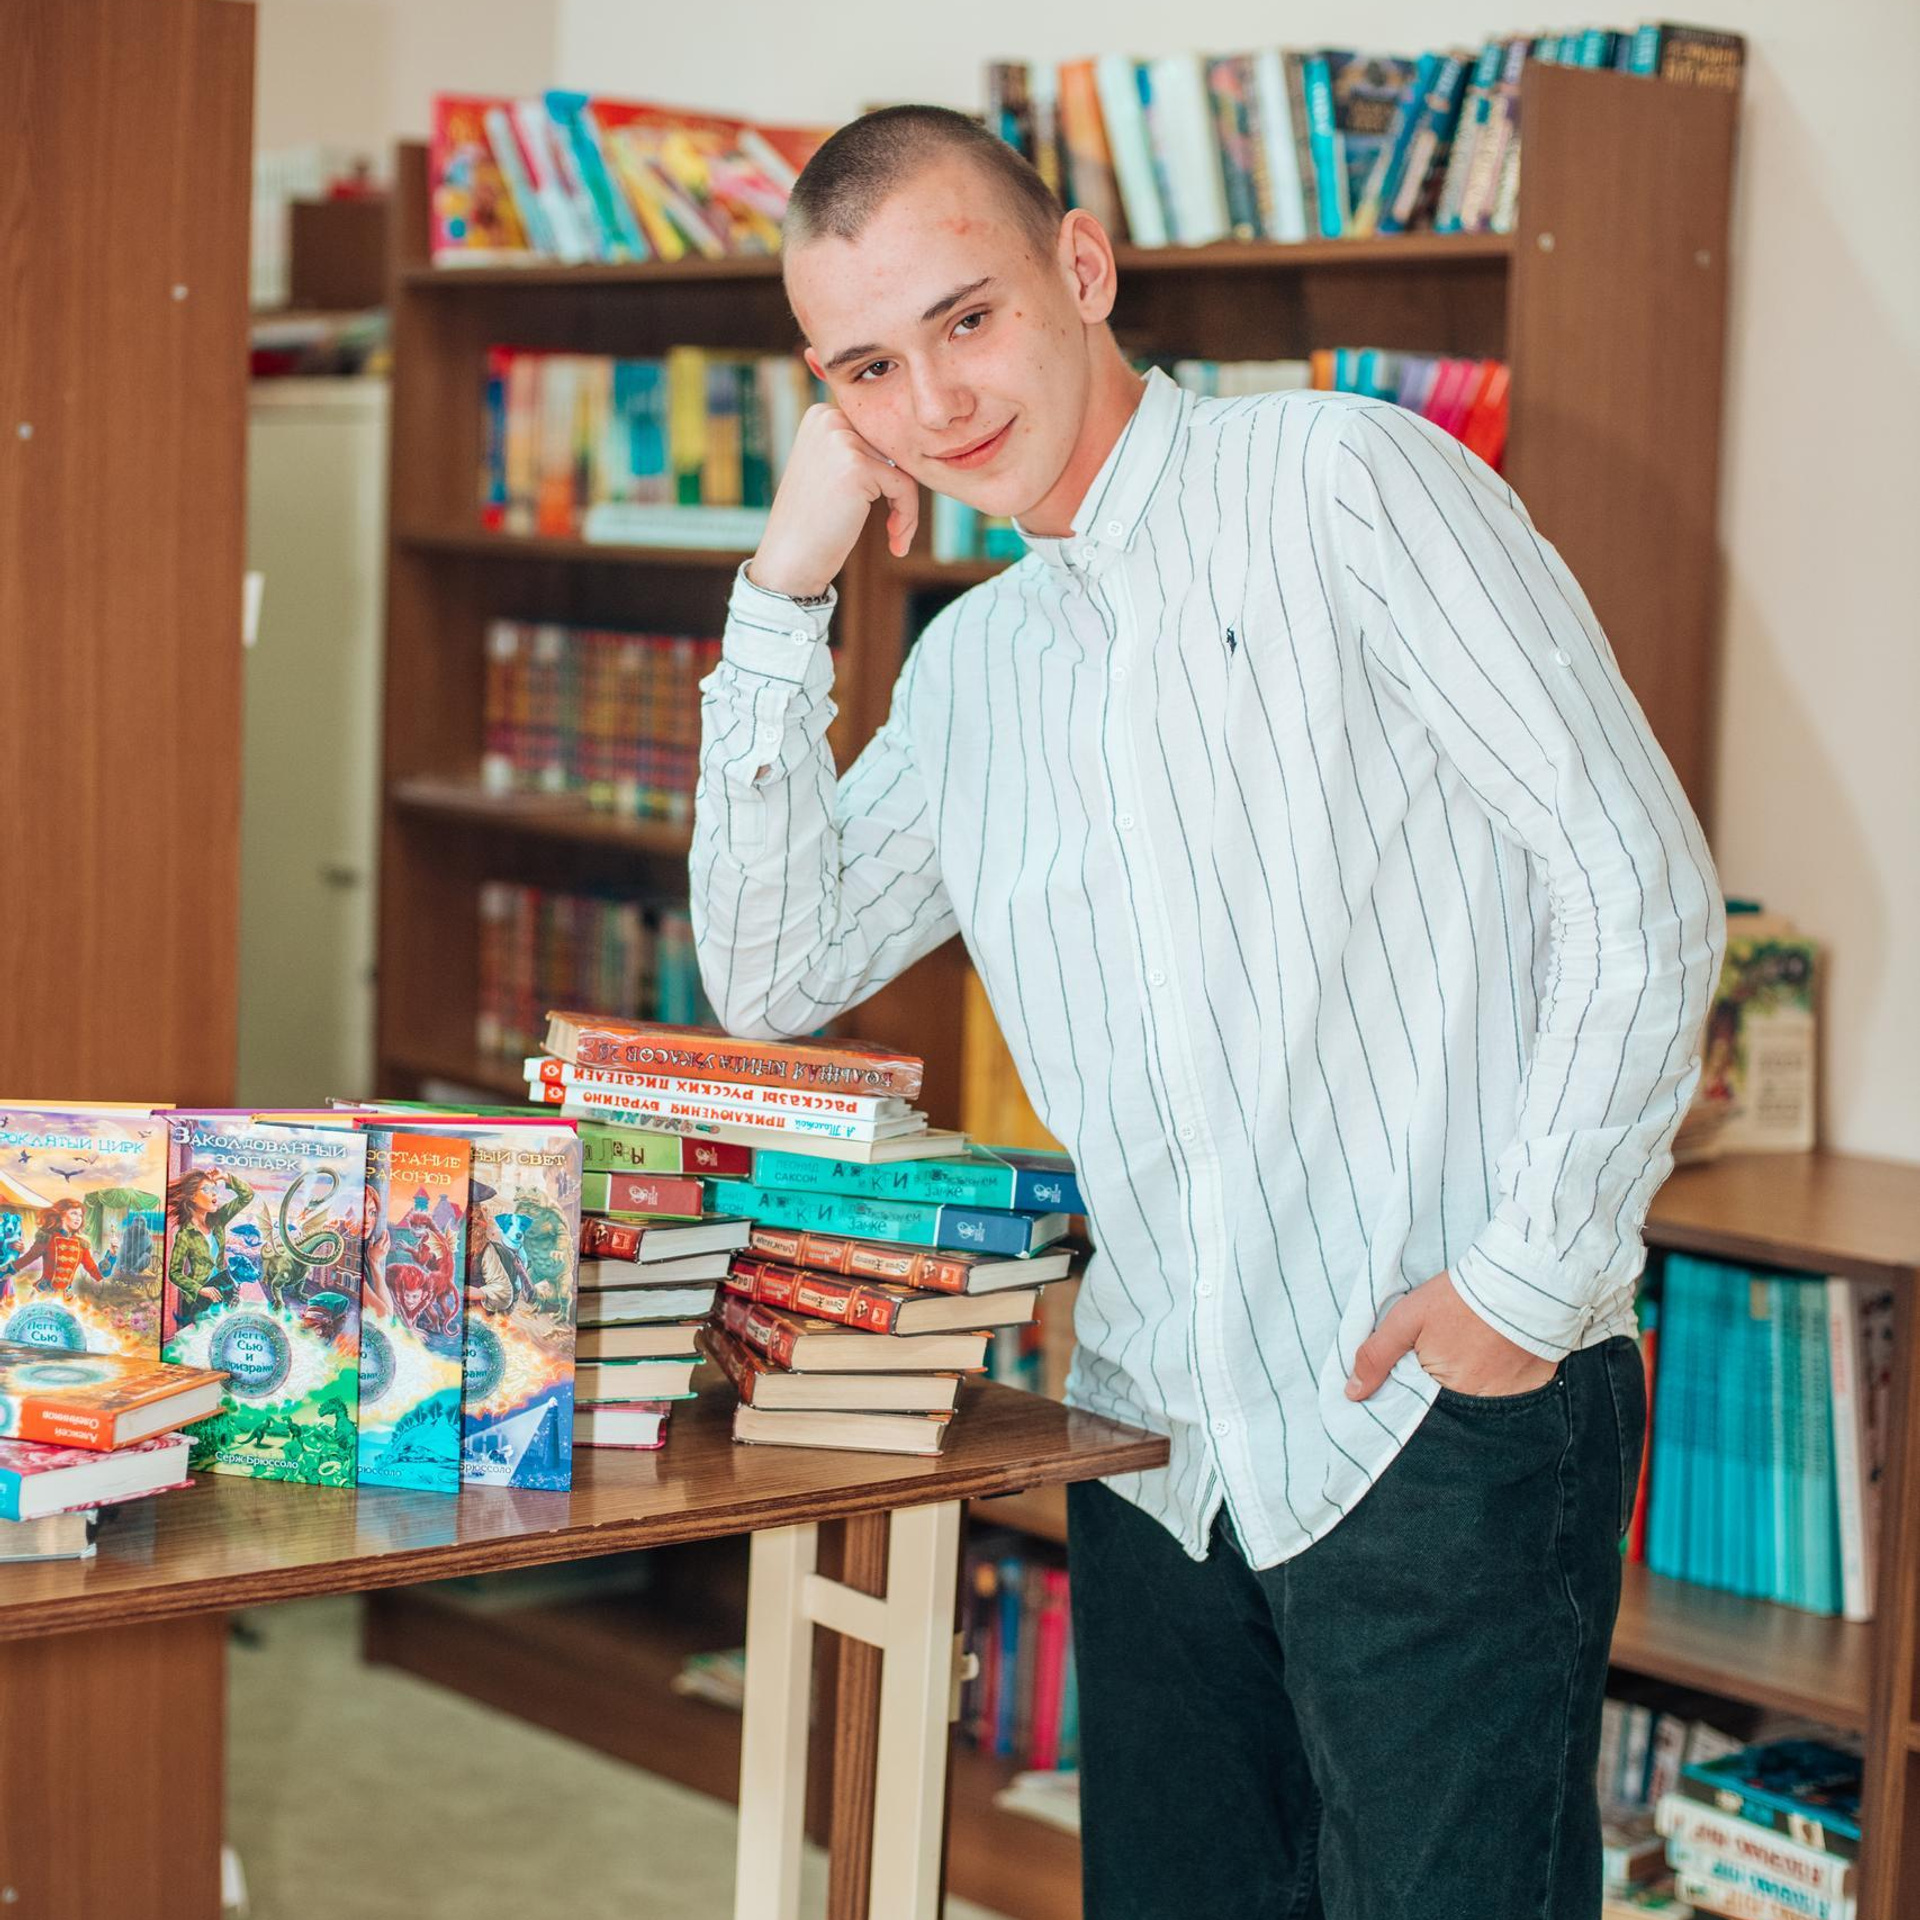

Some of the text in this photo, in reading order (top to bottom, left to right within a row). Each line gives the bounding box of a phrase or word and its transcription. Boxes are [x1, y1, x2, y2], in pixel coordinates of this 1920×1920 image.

[626, 1045, 716, 1069] УЖАСОВ
[718, 1055, 788, 1078] КНИГА
[792, 1062, 894, 1087] БОЛЬШАЯ
[583, 1091, 660, 1112] БУРАТИНО
[670, 1102, 786, 1128] ПРИКЛЮЧЕНИЯ
[795, 1119, 842, 1137] Толстой
[98, 1139, 145, 1154] ЦИРК
[215, 1153, 300, 1171] ЗООПАРК
[518, 1151, 565, 1166] СВЕТ
[774, 1172, 818, 1183] САКСОН
[31, 1331, 58, 1343] Сью
[237, 1340, 263, 1352] Сью
[245, 1353, 254, 1361] и
[215, 1451, 299, 1469] Серж Брюссоло
